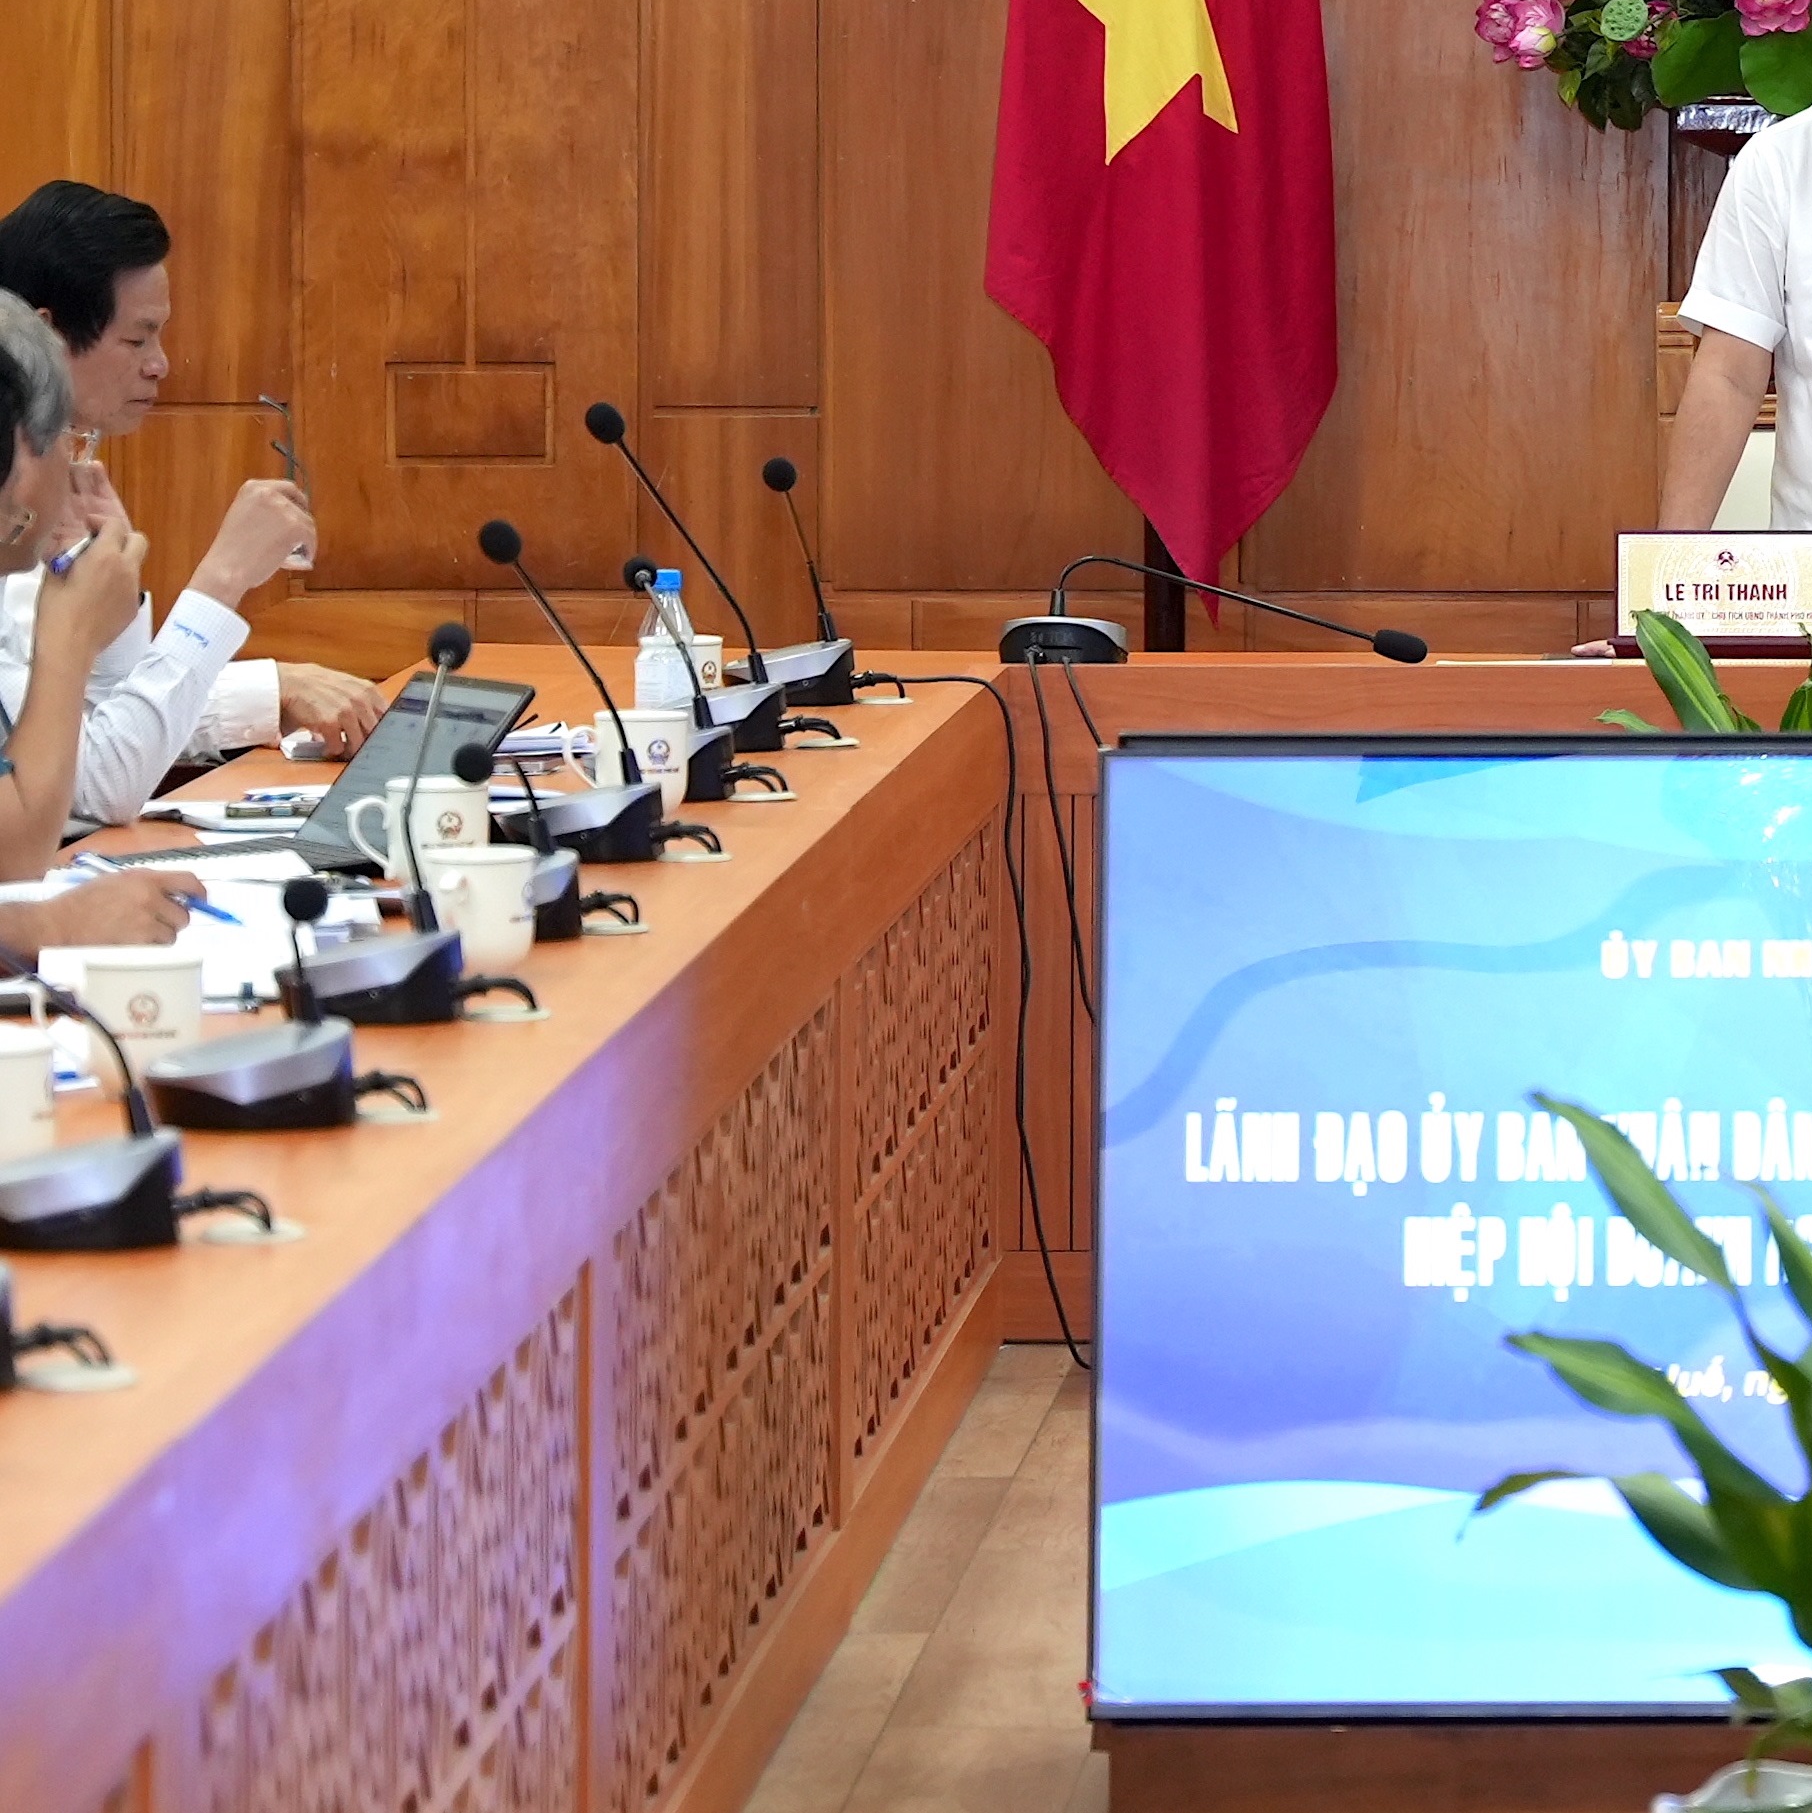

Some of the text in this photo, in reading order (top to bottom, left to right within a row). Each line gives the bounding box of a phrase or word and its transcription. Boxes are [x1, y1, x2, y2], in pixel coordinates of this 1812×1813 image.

[1727, 583, 1787, 601] THANH
[1670, 939, 1751, 978] BAN
[1185, 1096, 1300, 1182] LÃNH
[1313, 1110, 1408, 1196] ĐẠO
[1420, 1091, 1484, 1183] ỦY
[1404, 1202, 1507, 1302] HIỆP
[1518, 1202, 1594, 1302] HỘI
